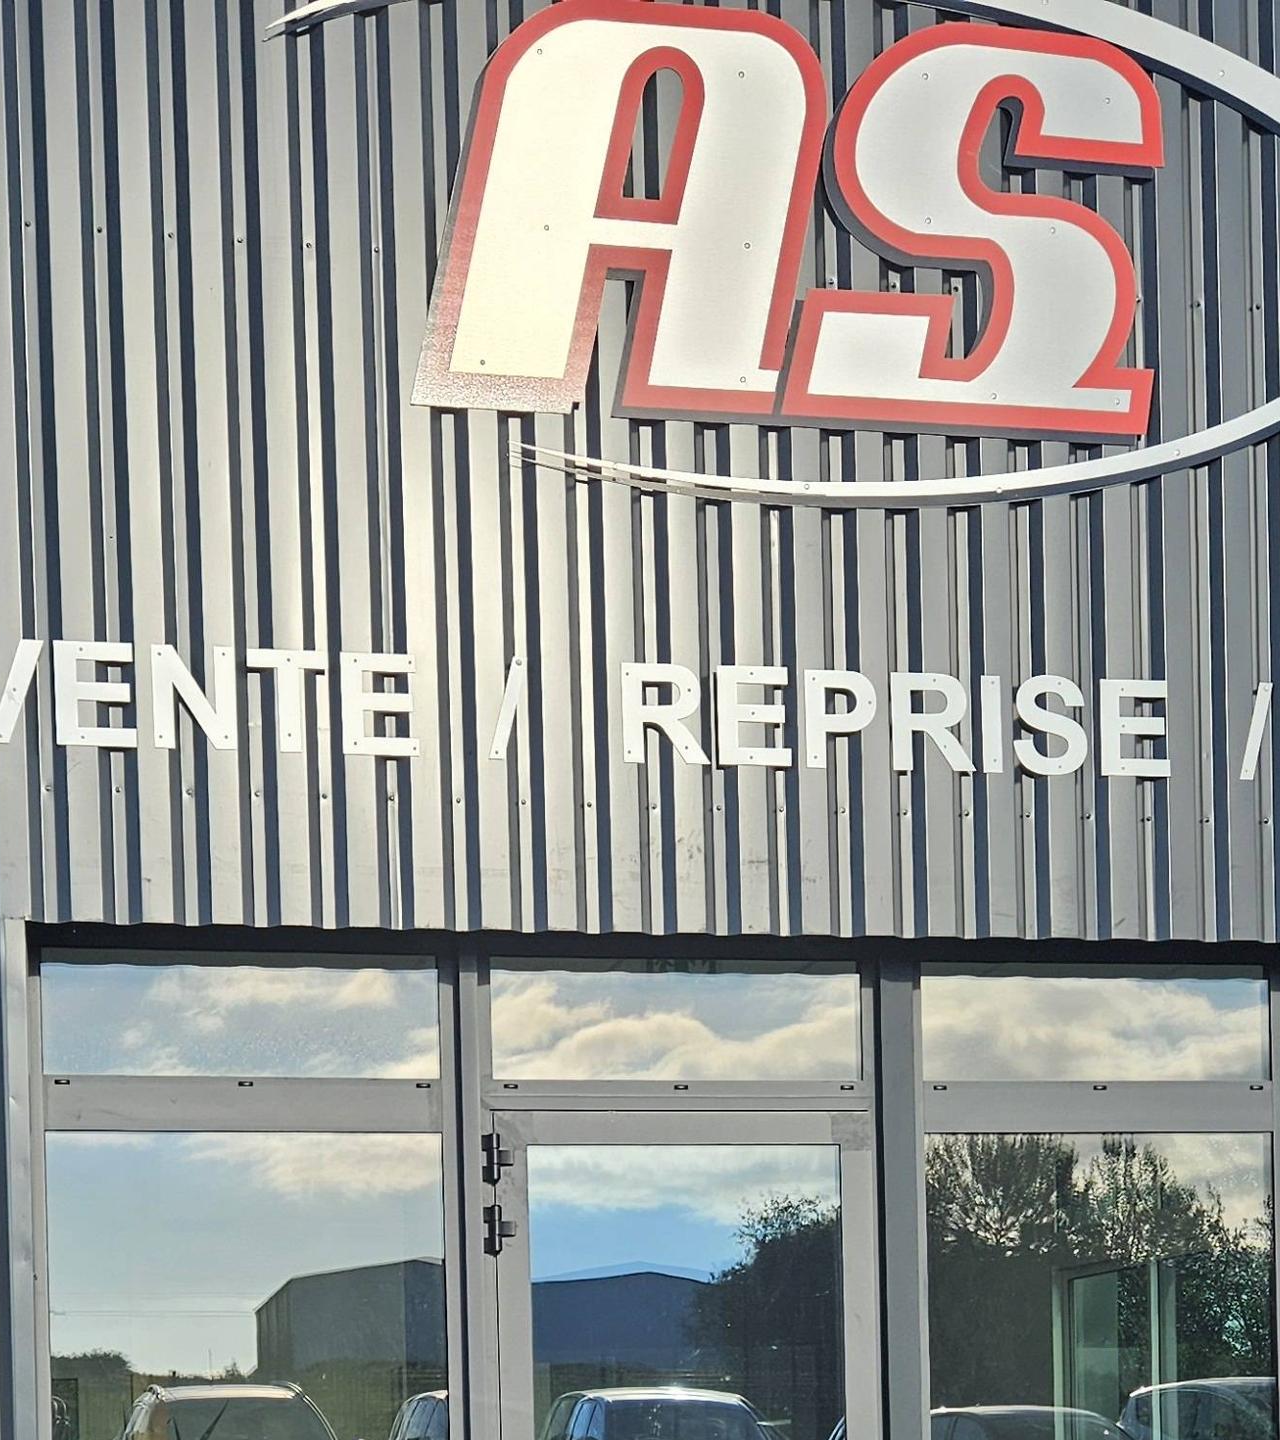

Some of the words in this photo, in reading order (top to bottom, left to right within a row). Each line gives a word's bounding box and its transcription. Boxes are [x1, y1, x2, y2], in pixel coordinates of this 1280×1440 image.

[411, 0, 1164, 435] AS
[488, 656, 527, 760] /
[621, 662, 1171, 777] REPRISE
[1239, 682, 1273, 780] /
